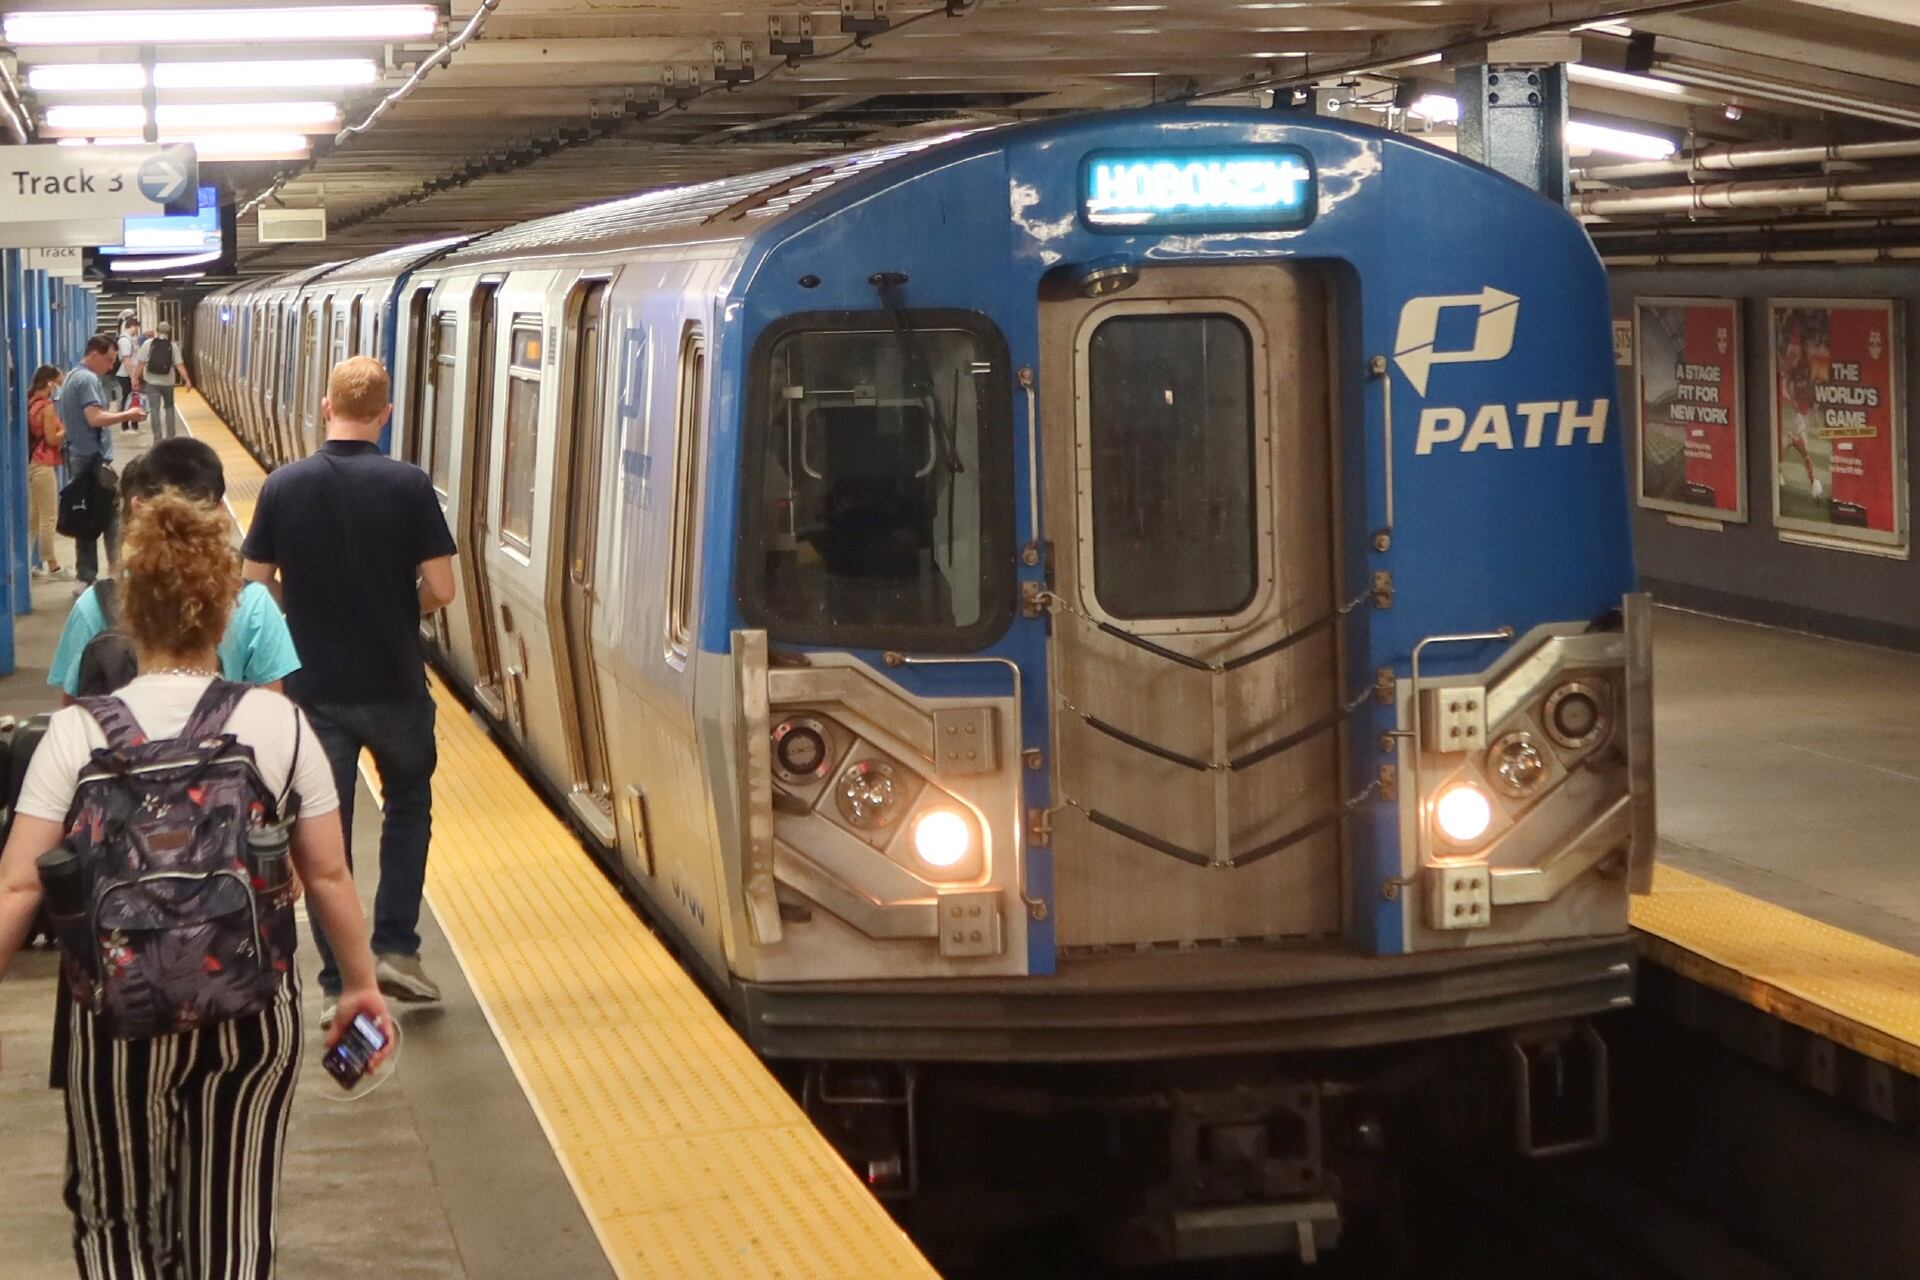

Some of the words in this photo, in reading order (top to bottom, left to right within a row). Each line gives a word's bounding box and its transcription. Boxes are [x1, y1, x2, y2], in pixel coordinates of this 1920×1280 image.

[11, 168, 96, 195] Track
[107, 168, 124, 193] 3
[1096, 161, 1294, 206] HOBOKEN
[40, 247, 76, 258] Track
[1676, 364, 1685, 379] A
[1685, 364, 1721, 382] STAGE
[1831, 363, 1859, 381] THE
[1678, 384, 1694, 400] FIT
[1695, 385, 1719, 403] FOR
[1814, 385, 1879, 407] WORLD'S
[1670, 403, 1695, 422] NEW
[1695, 406, 1729, 425] YORK
[1825, 409, 1868, 429] GAME
[1414, 399, 1610, 456] PATH
